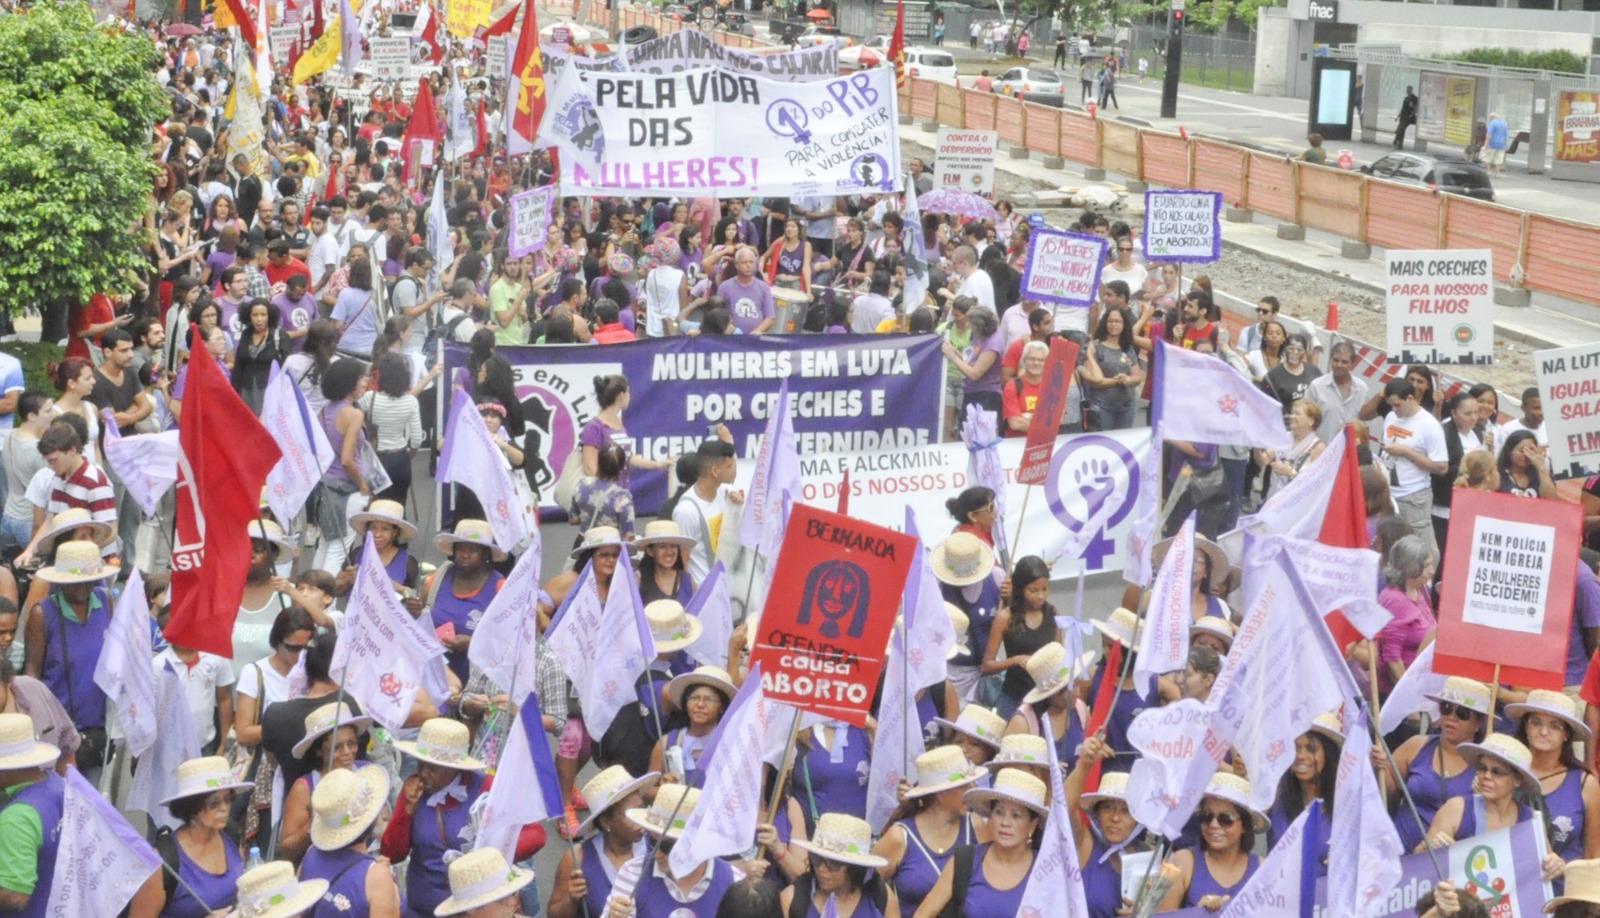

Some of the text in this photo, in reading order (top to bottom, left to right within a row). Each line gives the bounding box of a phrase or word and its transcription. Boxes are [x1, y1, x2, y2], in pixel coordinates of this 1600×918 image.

[1309, 1, 1334, 19] fnac
[766, 43, 838, 76] CALARÁ!
[596, 76, 677, 109] PELA
[811, 100, 834, 120] DO
[628, 117, 694, 147] DAS
[785, 107, 889, 167] PARA COMBATER
[946, 133, 980, 143] CONTRA
[1563, 143, 1599, 160] MAIS
[573, 156, 759, 191] MULHERES!
[805, 168, 816, 178] A
[943, 173, 961, 184] FLM
[1169, 210, 1183, 222] NOS
[1041, 236, 1057, 255] AS
[1150, 237, 1164, 247] DO
[1389, 259, 1488, 277] MAIS CRECHES
[1390, 283, 1489, 296] PARA NOSSOS
[1408, 298, 1470, 314] FILHOS
[1402, 326, 1434, 342] FLM
[652, 348, 913, 382] MULHERES EM LUTA
[1542, 357, 1566, 376] NA
[533, 368, 570, 395] em
[686, 393, 743, 422] POR
[870, 389, 886, 416] E
[1567, 431, 1600, 454] FLM
[837, 457, 849, 474] E
[854, 450, 950, 473] ALCKMIN:
[874, 472, 947, 494] NOSSOS
[1480, 531, 1547, 553] NEM POLÍCIA
[1478, 547, 1543, 571] NEM IGREJA
[1474, 566, 1541, 590] AS MULHERES
[1168, 580, 1184, 621] CORAÇÃO
[1472, 581, 1540, 604] DECIDEM!!
[779, 655, 851, 676] causa
[760, 671, 868, 705] ABORTO
